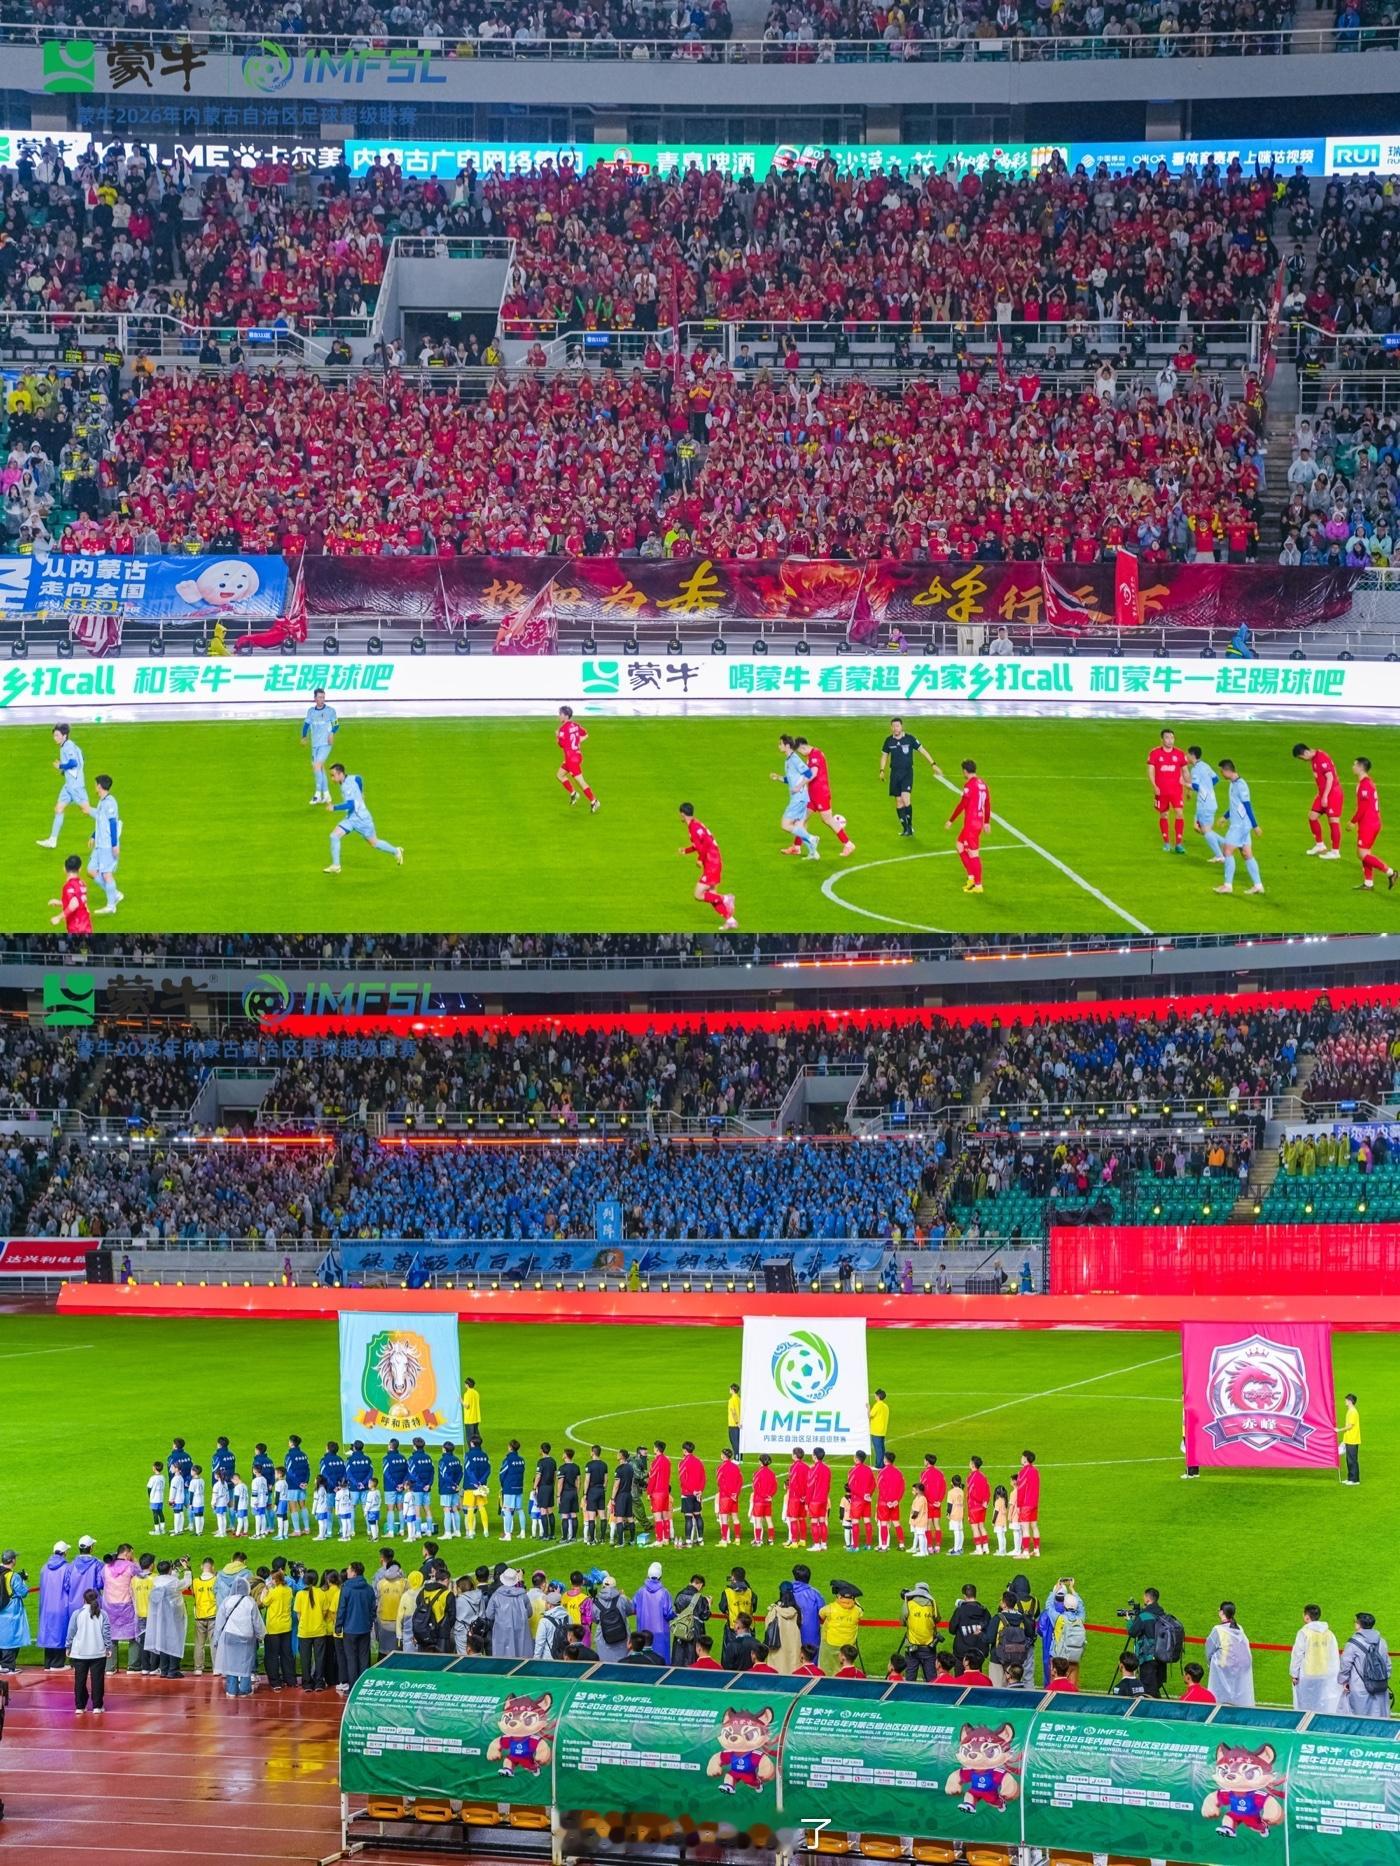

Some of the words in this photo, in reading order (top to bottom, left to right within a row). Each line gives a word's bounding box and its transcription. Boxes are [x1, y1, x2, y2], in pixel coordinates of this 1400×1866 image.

[1337, 148, 1377, 163] RUI
[41, 559, 149, 581] 从内蒙古
[38, 581, 146, 600] 走向全国
[133, 663, 394, 694] 和蒙牛一起踢球吧
[627, 661, 700, 693] 蒙牛
[729, 663, 811, 694] 喝蒙牛
[817, 666, 901, 693] 看蒙超
[904, 663, 1073, 700] 为家乡打call
[1090, 665, 1345, 696] 和蒙牛一起踢球吧
[380, 1416, 421, 1429] 呼和浩特
[759, 1409, 851, 1432] IMFSL
[1242, 1417, 1277, 1430] 赤峰
[763, 1434, 847, 1443] 内蒙古自治区足球超级联赛
